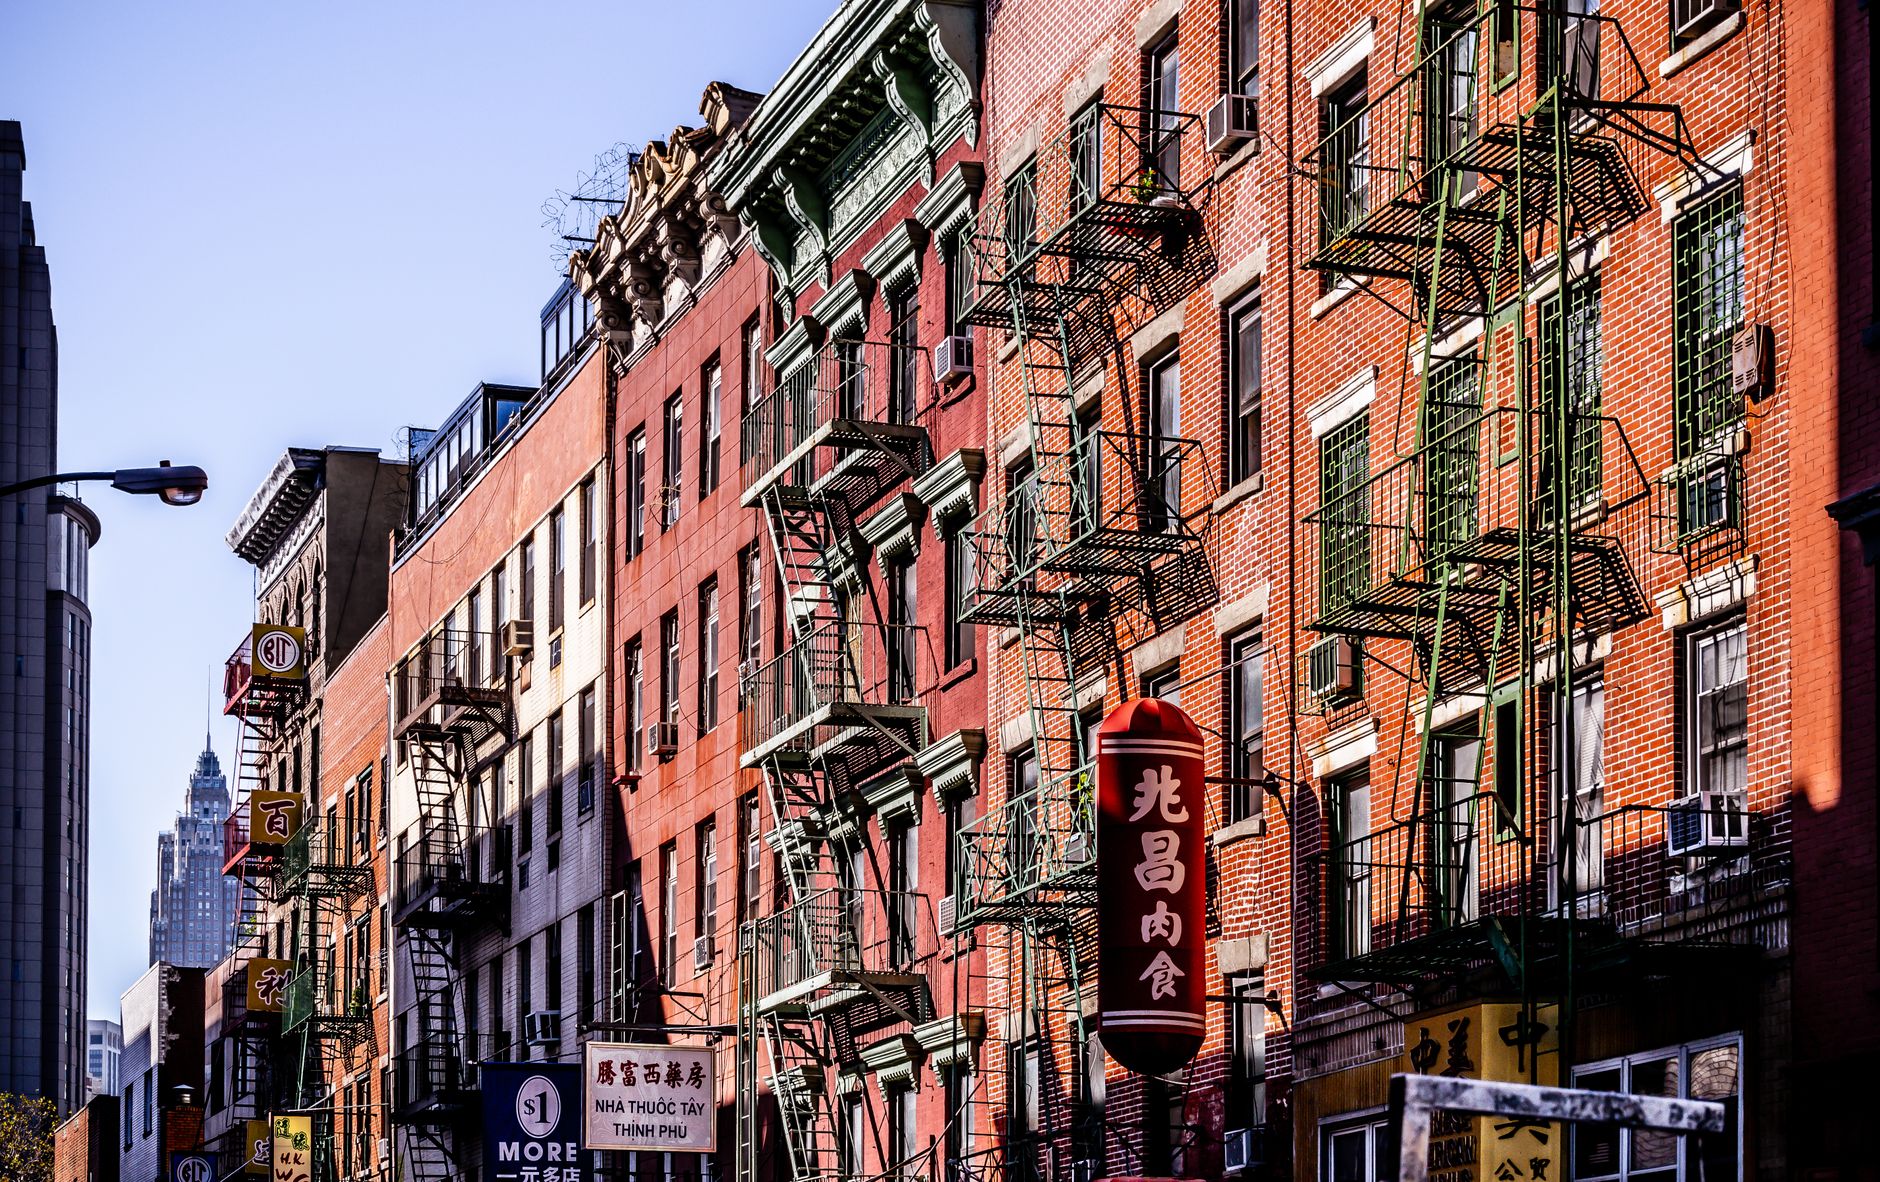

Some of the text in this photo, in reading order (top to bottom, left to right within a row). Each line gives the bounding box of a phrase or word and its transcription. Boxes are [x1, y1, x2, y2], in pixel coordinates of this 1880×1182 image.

[263, 636, 292, 667] BLT
[257, 798, 296, 839] 百
[1128, 763, 1190, 1002] 兆昌肉食
[596, 1058, 707, 1090] 騰富西藥房
[523, 1091, 551, 1124] $1
[595, 1095, 626, 1114] NHÀ
[680, 1096, 706, 1116] TÂY
[280, 1152, 305, 1166] H.K.
[498, 1141, 578, 1162] MORE
